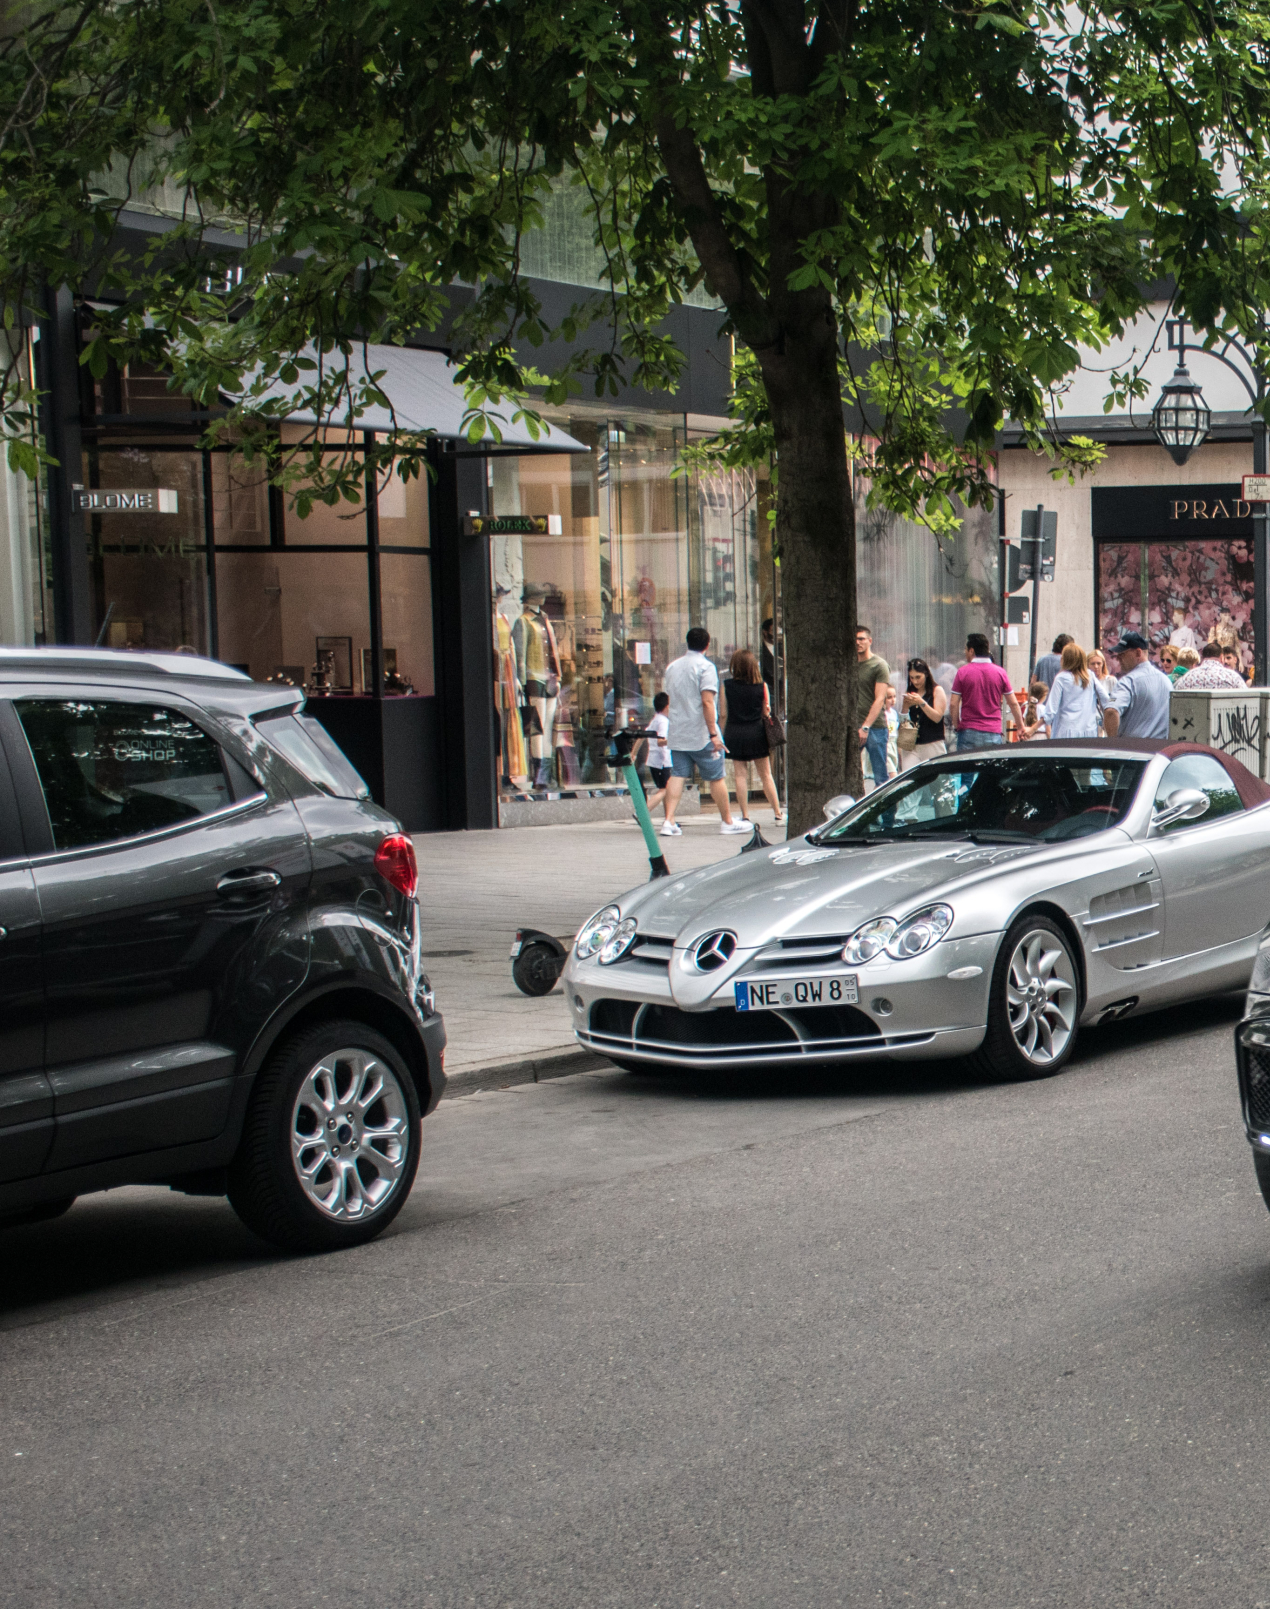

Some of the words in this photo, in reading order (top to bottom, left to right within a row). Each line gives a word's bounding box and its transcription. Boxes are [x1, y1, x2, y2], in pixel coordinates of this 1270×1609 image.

[79, 493, 153, 509] BLOME
[1170, 499, 1251, 519] PRAD
[490, 520, 531, 531] ROLEX
[131, 740, 175, 749] ONLINE
[131, 750, 176, 761] SHOP
[749, 983, 780, 1006] NE
[794, 981, 823, 1003] QW
[829, 980, 842, 1001] 8
